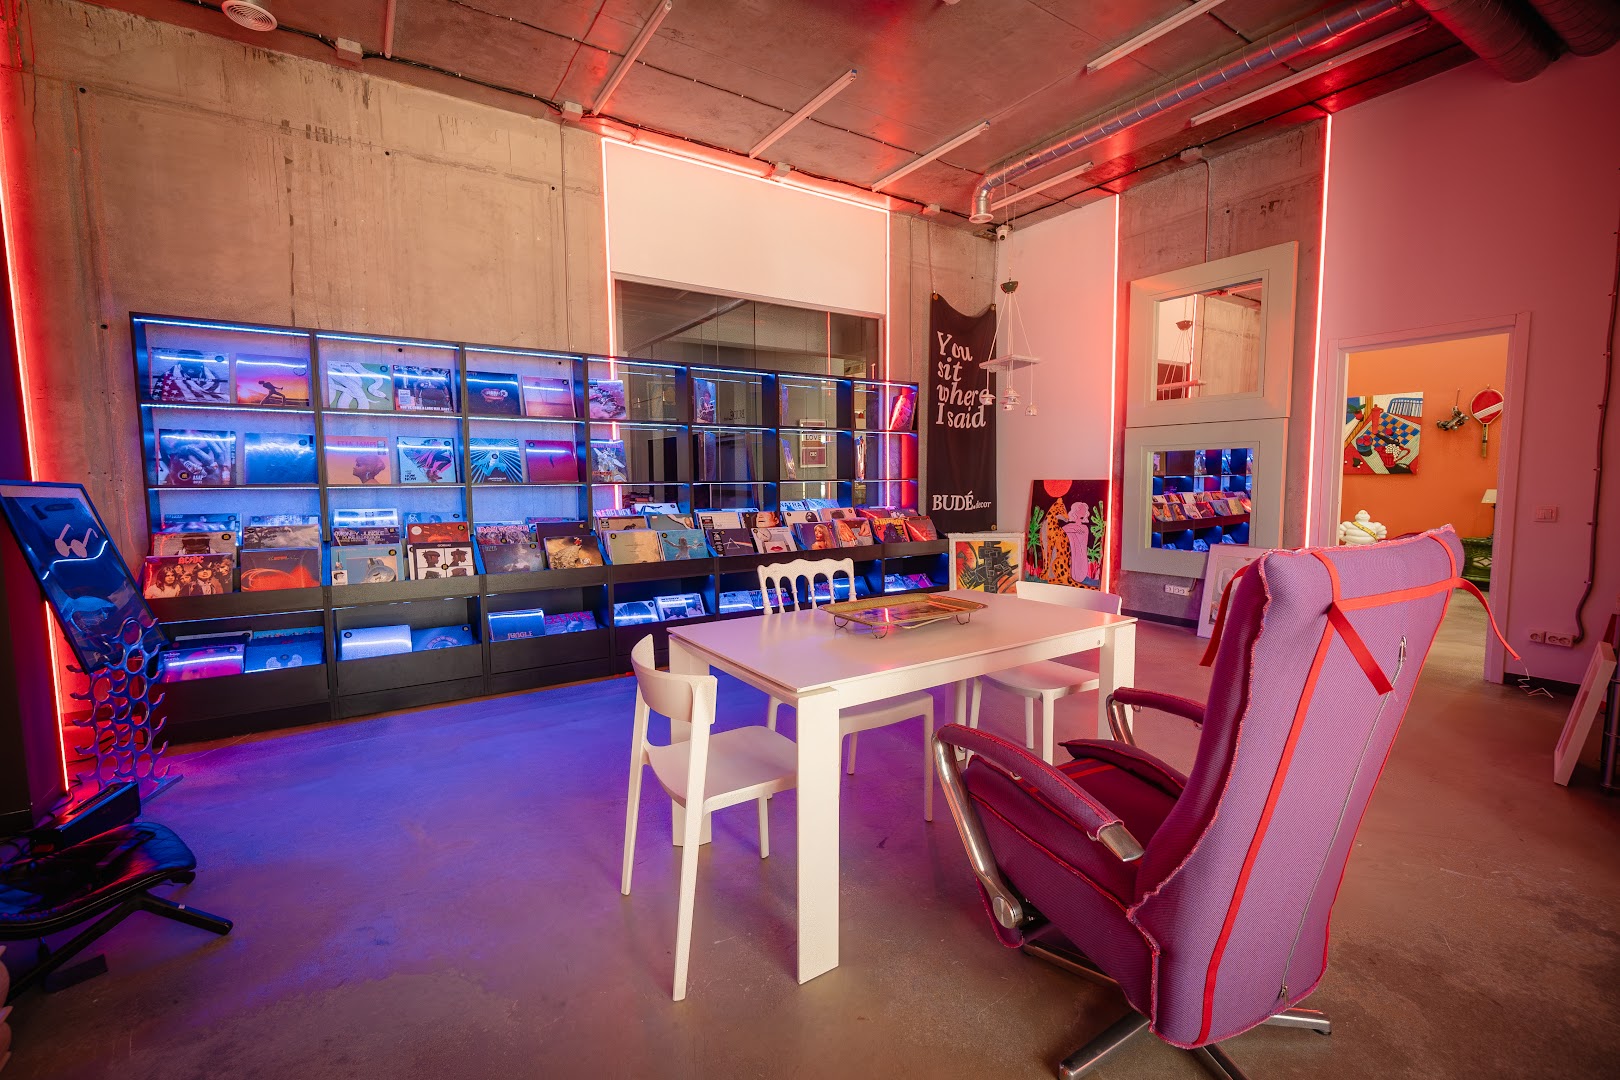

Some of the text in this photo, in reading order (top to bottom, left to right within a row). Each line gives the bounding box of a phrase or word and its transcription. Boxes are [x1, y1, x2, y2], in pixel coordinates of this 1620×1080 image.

[936, 330, 973, 362] You
[937, 356, 962, 382] sit
[936, 381, 990, 406] where
[936, 402, 986, 429] I said
[932, 490, 974, 510] BUDÉ
[178, 556, 204, 564] AC/DC
